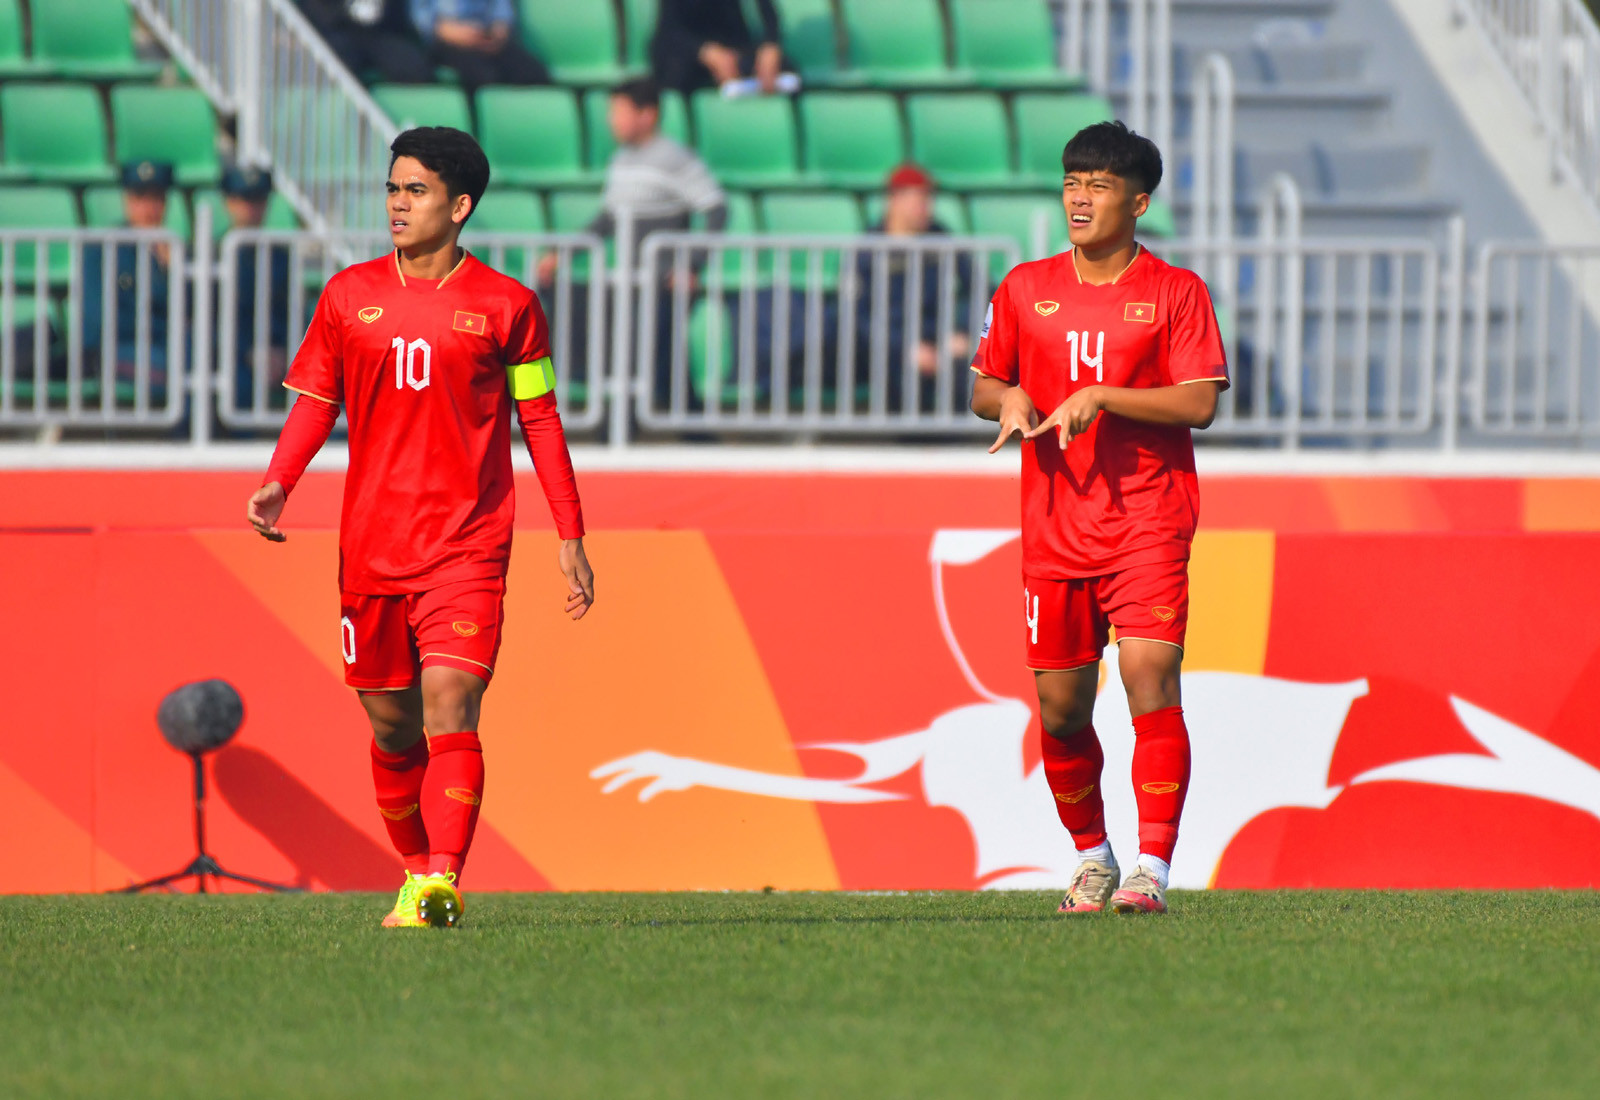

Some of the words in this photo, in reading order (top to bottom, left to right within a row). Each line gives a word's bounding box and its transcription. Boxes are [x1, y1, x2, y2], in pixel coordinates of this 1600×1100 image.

[392, 336, 431, 391] 10
[1066, 330, 1105, 382] 14
[341, 616, 356, 665] 0
[1025, 587, 1039, 645] 4
